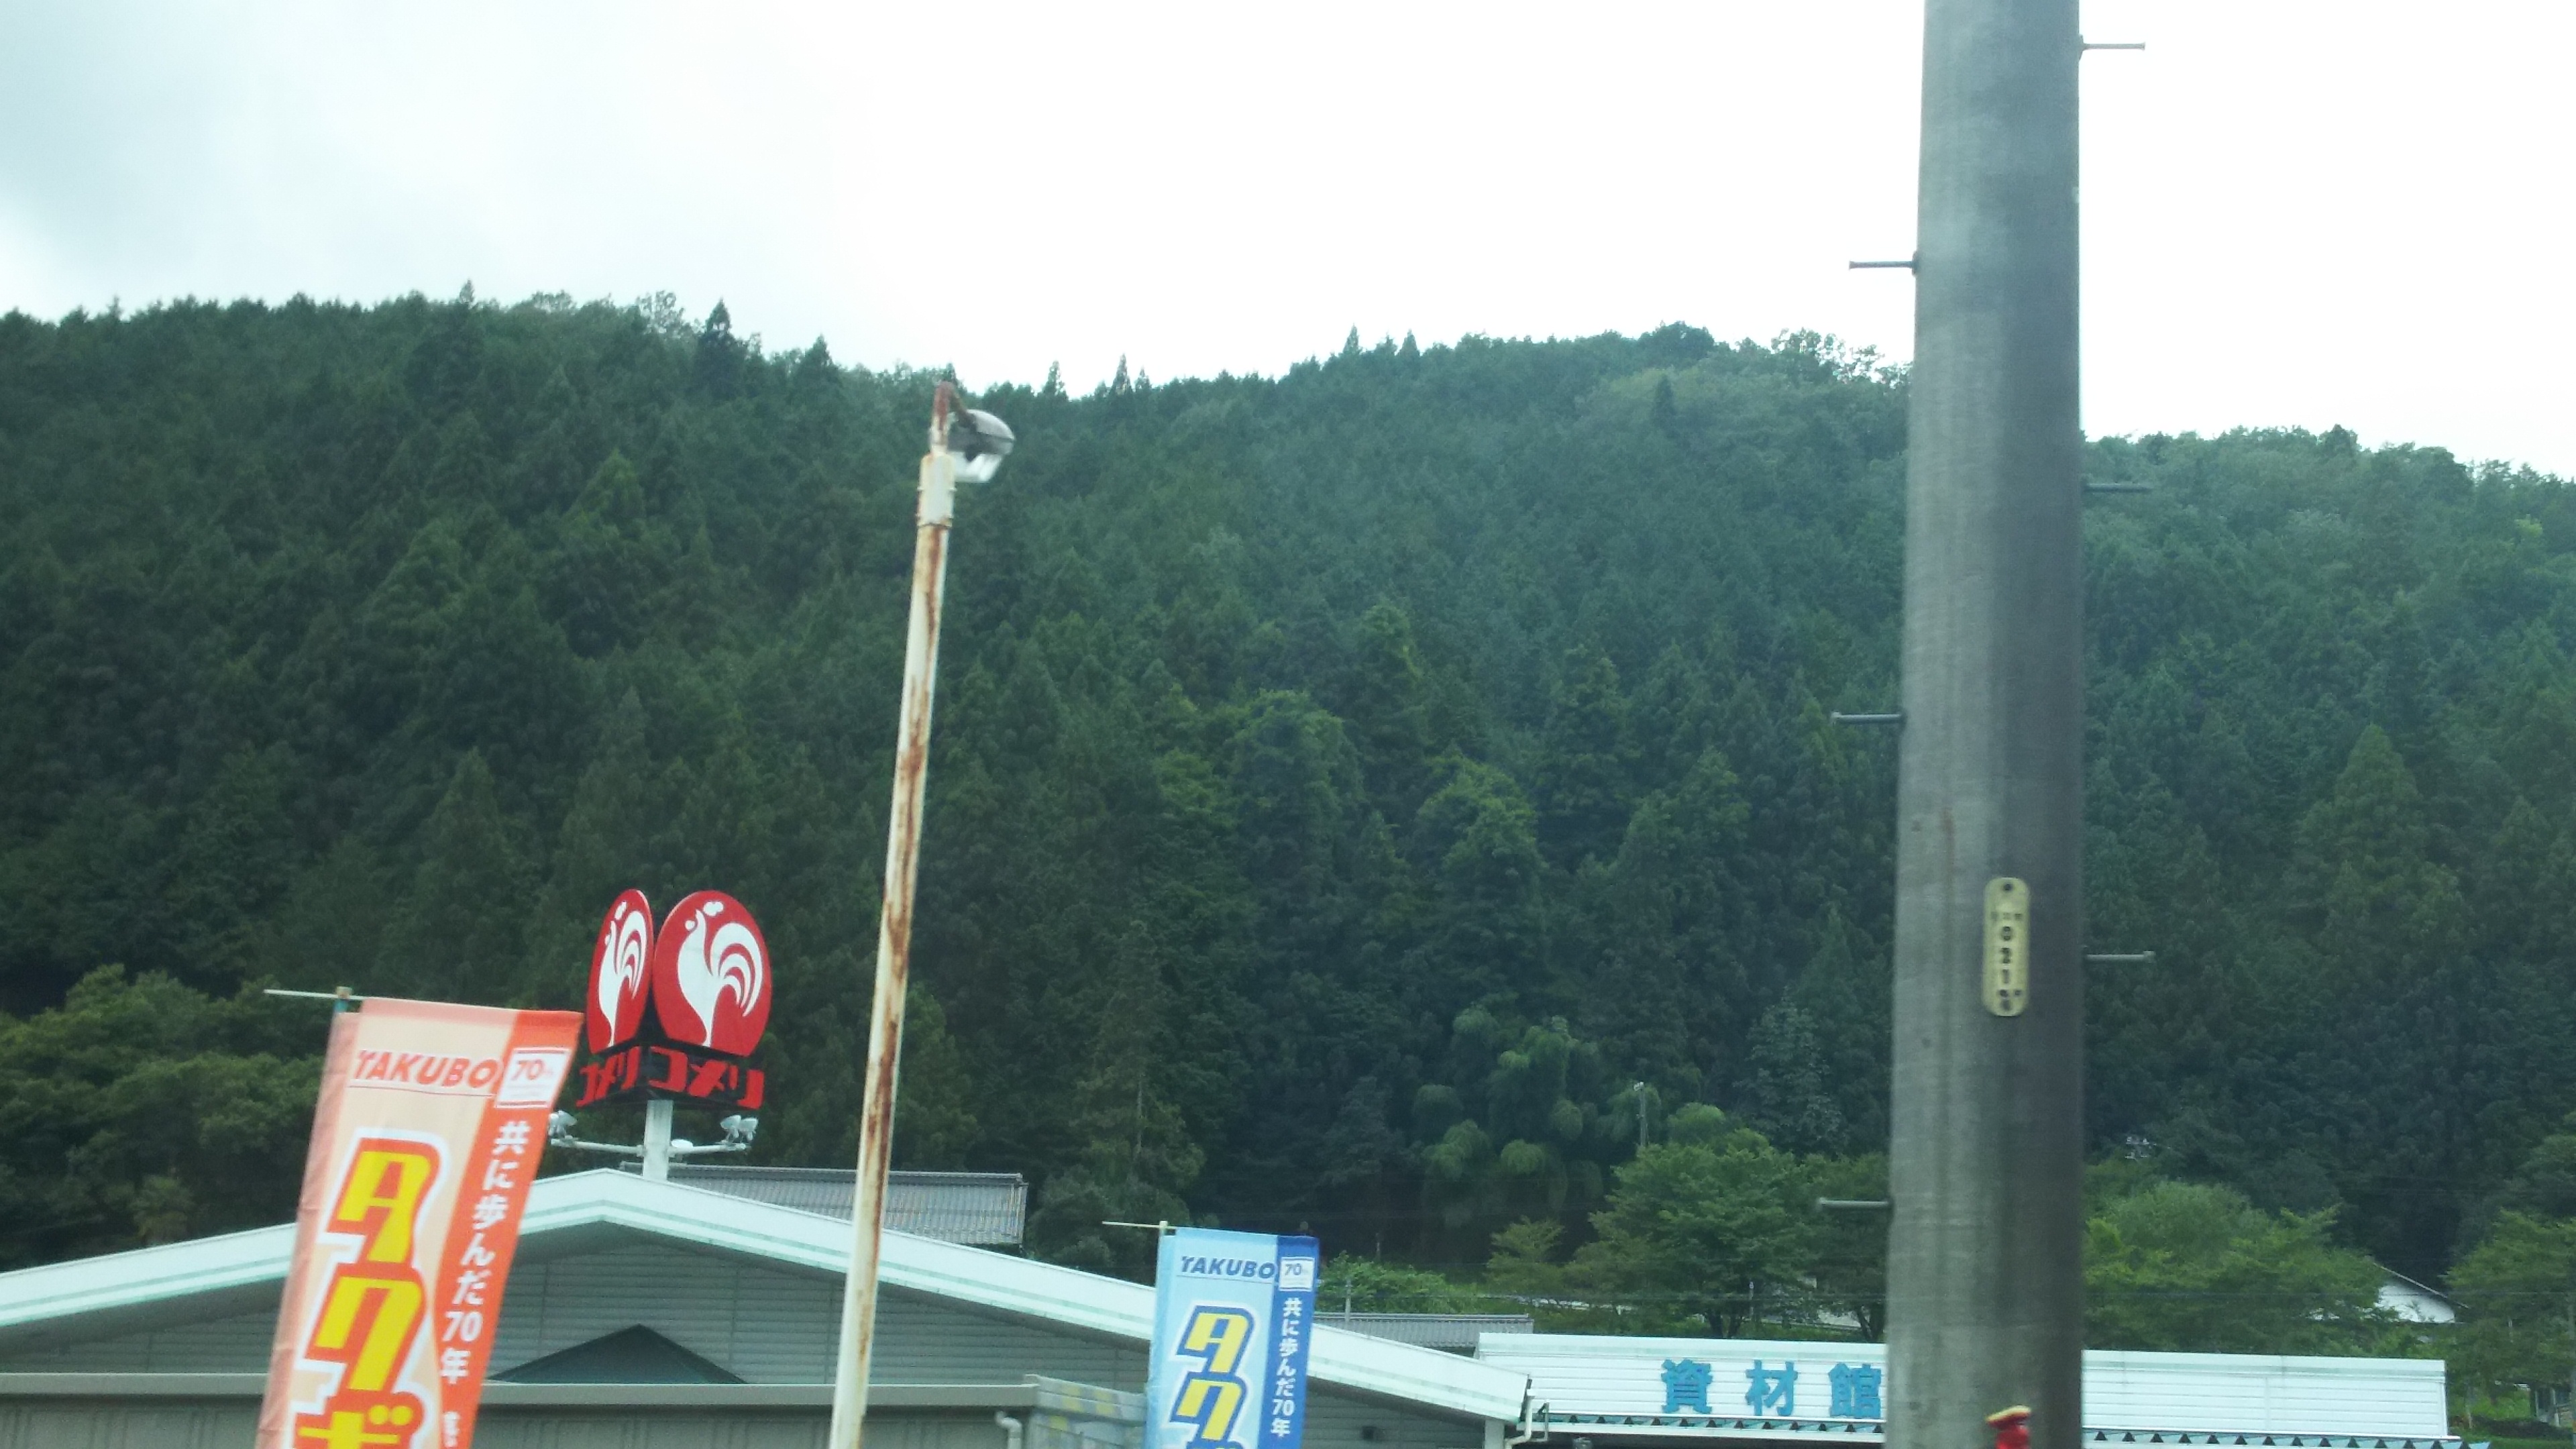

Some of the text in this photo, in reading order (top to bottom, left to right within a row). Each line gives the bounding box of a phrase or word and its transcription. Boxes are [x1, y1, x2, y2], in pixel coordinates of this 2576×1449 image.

[351, 1050, 504, 1088] TAKUBO
[648, 1045, 765, 1110] コメリ
[439, 1122, 531, 1384] 共に歩んだ70年
[1180, 1256, 1276, 1279] TAKUBO
[1171, 1307, 1254, 1449] タク
[1271, 1297, 1302, 1438] 共に歩んだ70年
[1660, 1358, 1882, 1419] 資材館
